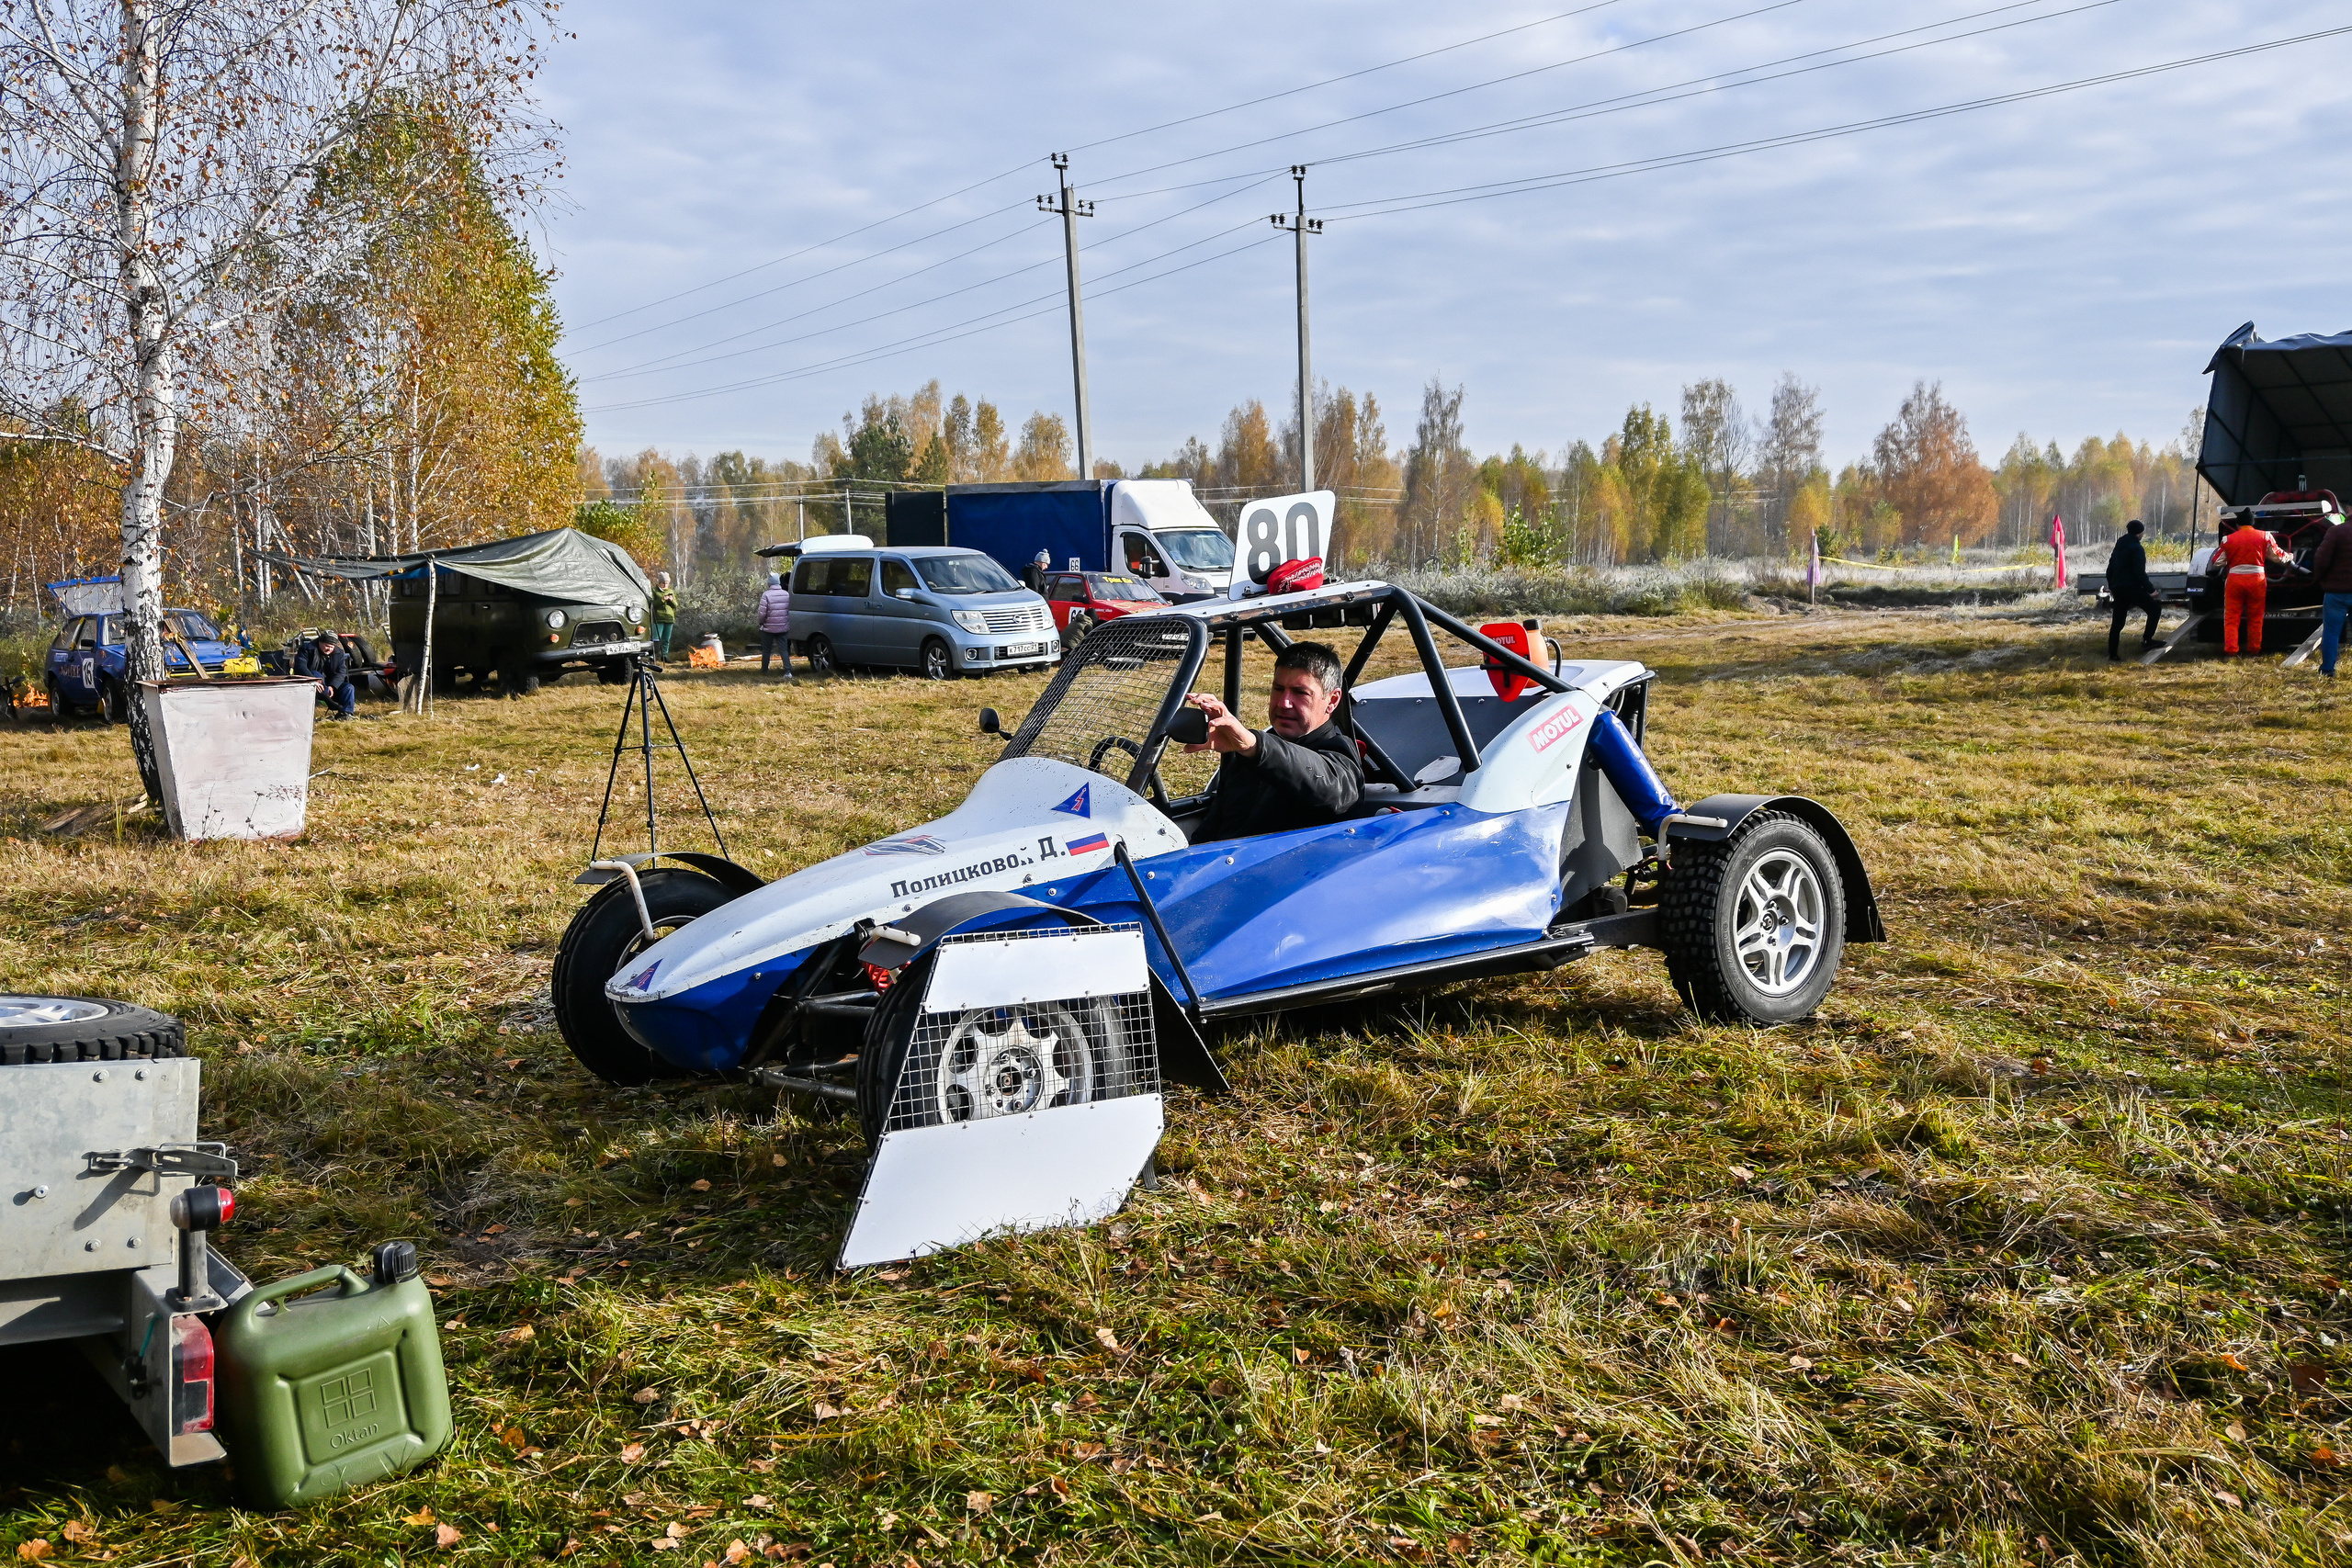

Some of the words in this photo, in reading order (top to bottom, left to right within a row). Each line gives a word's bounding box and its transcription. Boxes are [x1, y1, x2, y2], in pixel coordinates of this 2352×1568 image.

[1247, 502, 1320, 585] 80
[1070, 559, 1080, 571] 66
[84, 661, 93, 685] 16
[1532, 708, 1579, 750] MOTUL
[1037, 836, 1066, 861] Д.
[330, 1423, 379, 1449] Oktan
